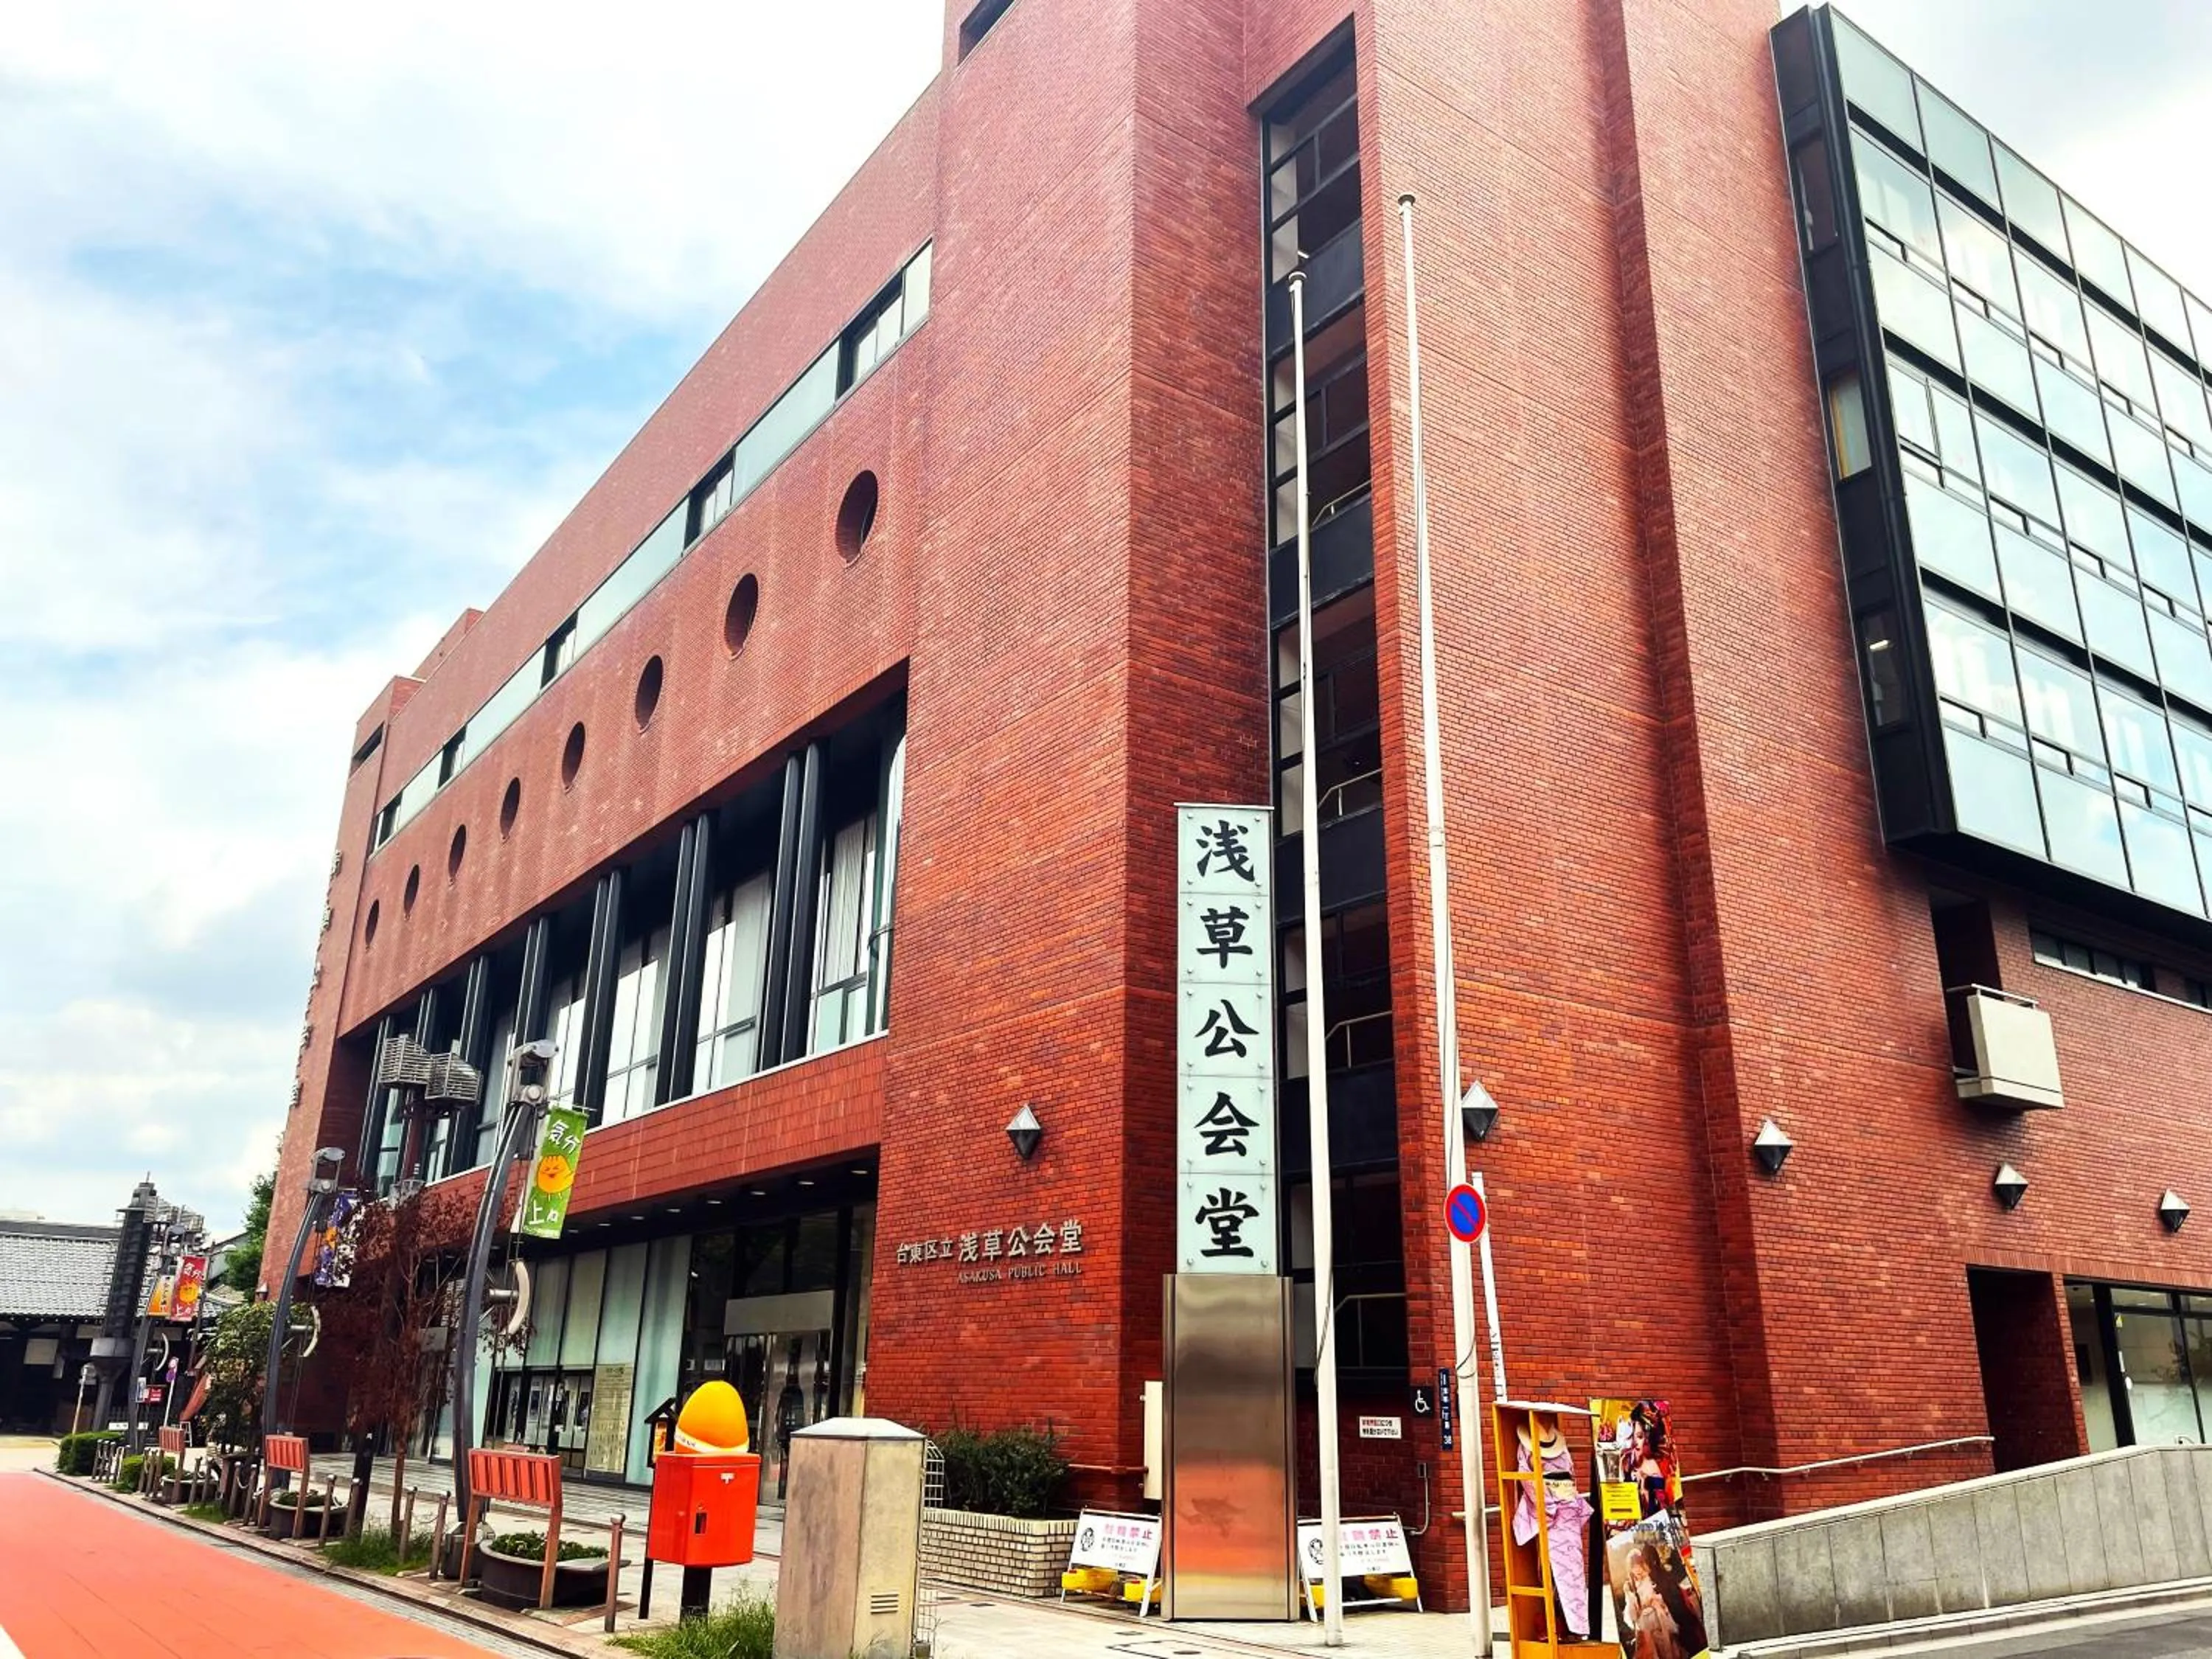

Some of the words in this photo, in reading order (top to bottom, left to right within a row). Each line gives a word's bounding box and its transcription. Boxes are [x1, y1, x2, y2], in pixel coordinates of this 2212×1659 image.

[1195, 820, 1260, 1258] 浅草公会堂
[549, 1120, 581, 1154] 気分
[896, 1237, 953, 1264] 台東区立
[959, 1219, 1082, 1262] 浅草公会堂
[959, 1267, 1002, 1284] ASAKUSA
[1008, 1263, 1045, 1278] PUBLIC
[1053, 1261, 1082, 1274] HALL
